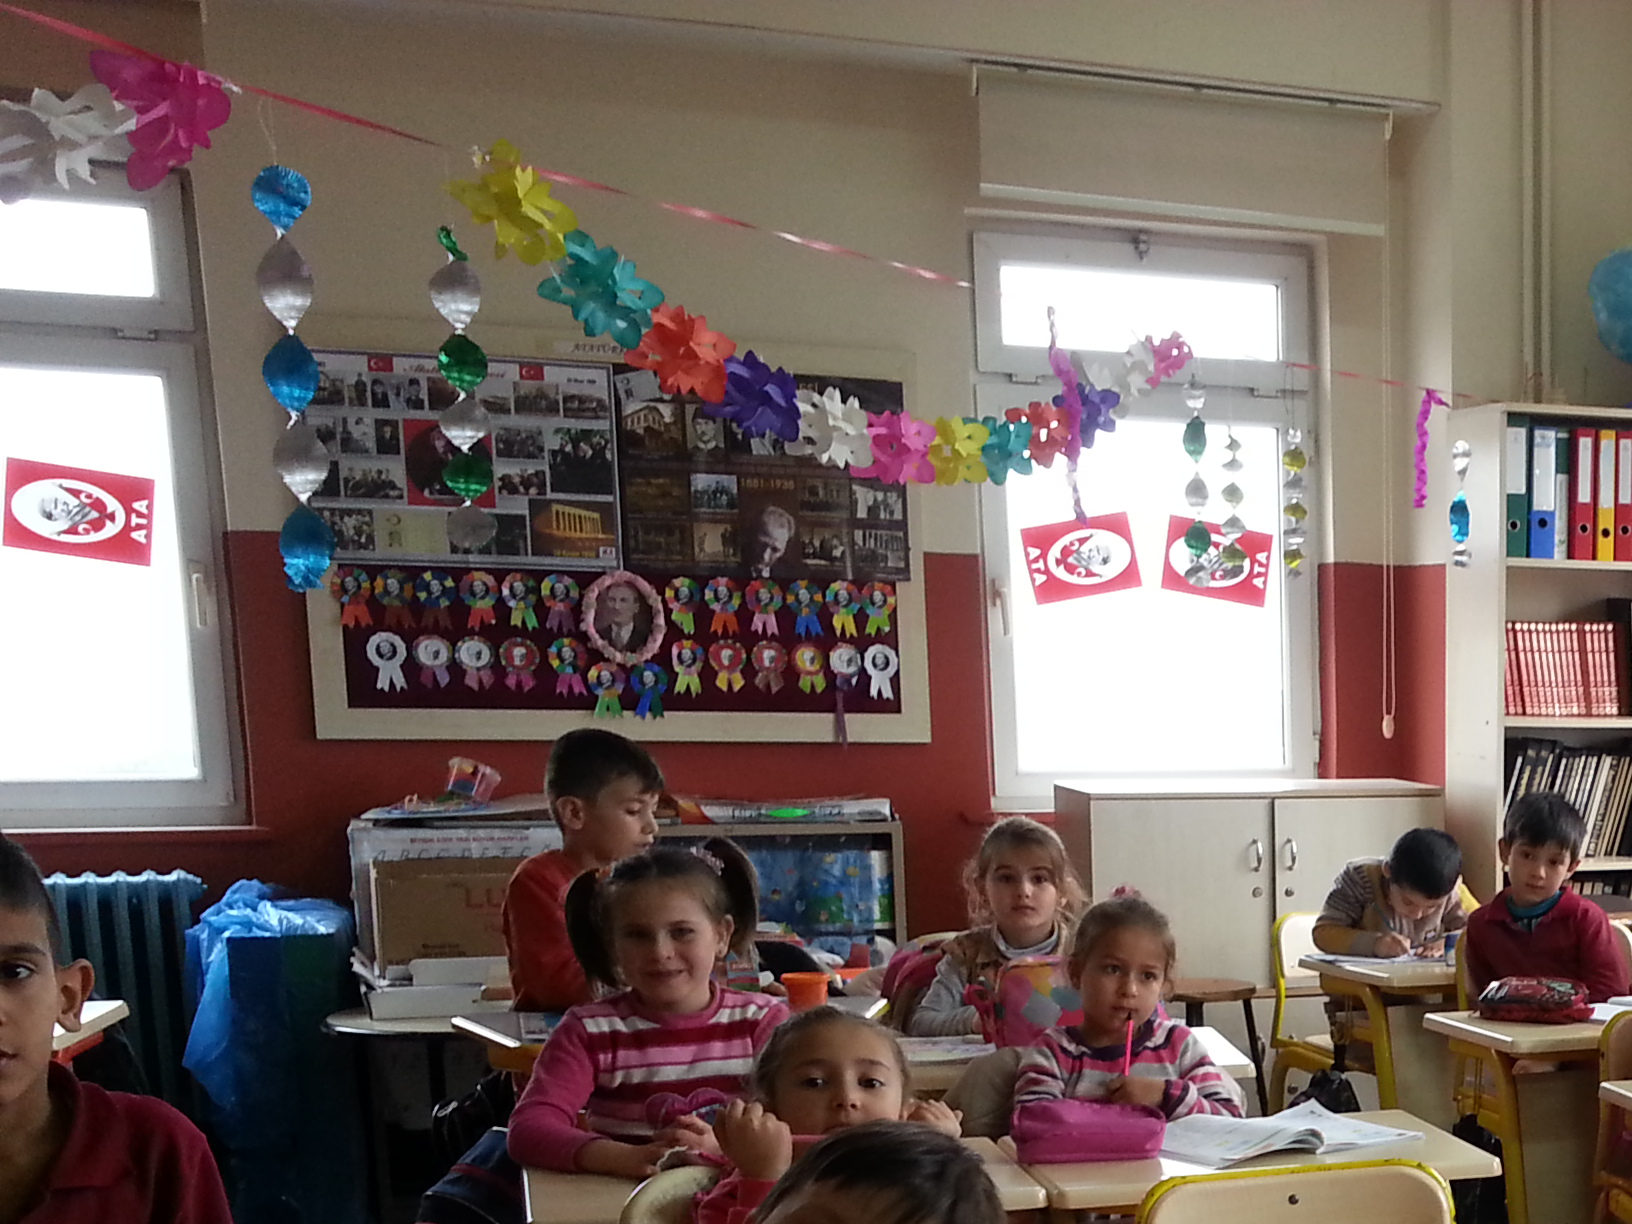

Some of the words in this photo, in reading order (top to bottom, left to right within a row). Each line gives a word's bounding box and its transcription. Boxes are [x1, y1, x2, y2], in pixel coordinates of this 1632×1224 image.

[130, 497, 150, 545] ATA
[1027, 546, 1047, 588] ATA
[1252, 551, 1269, 590] ATA
